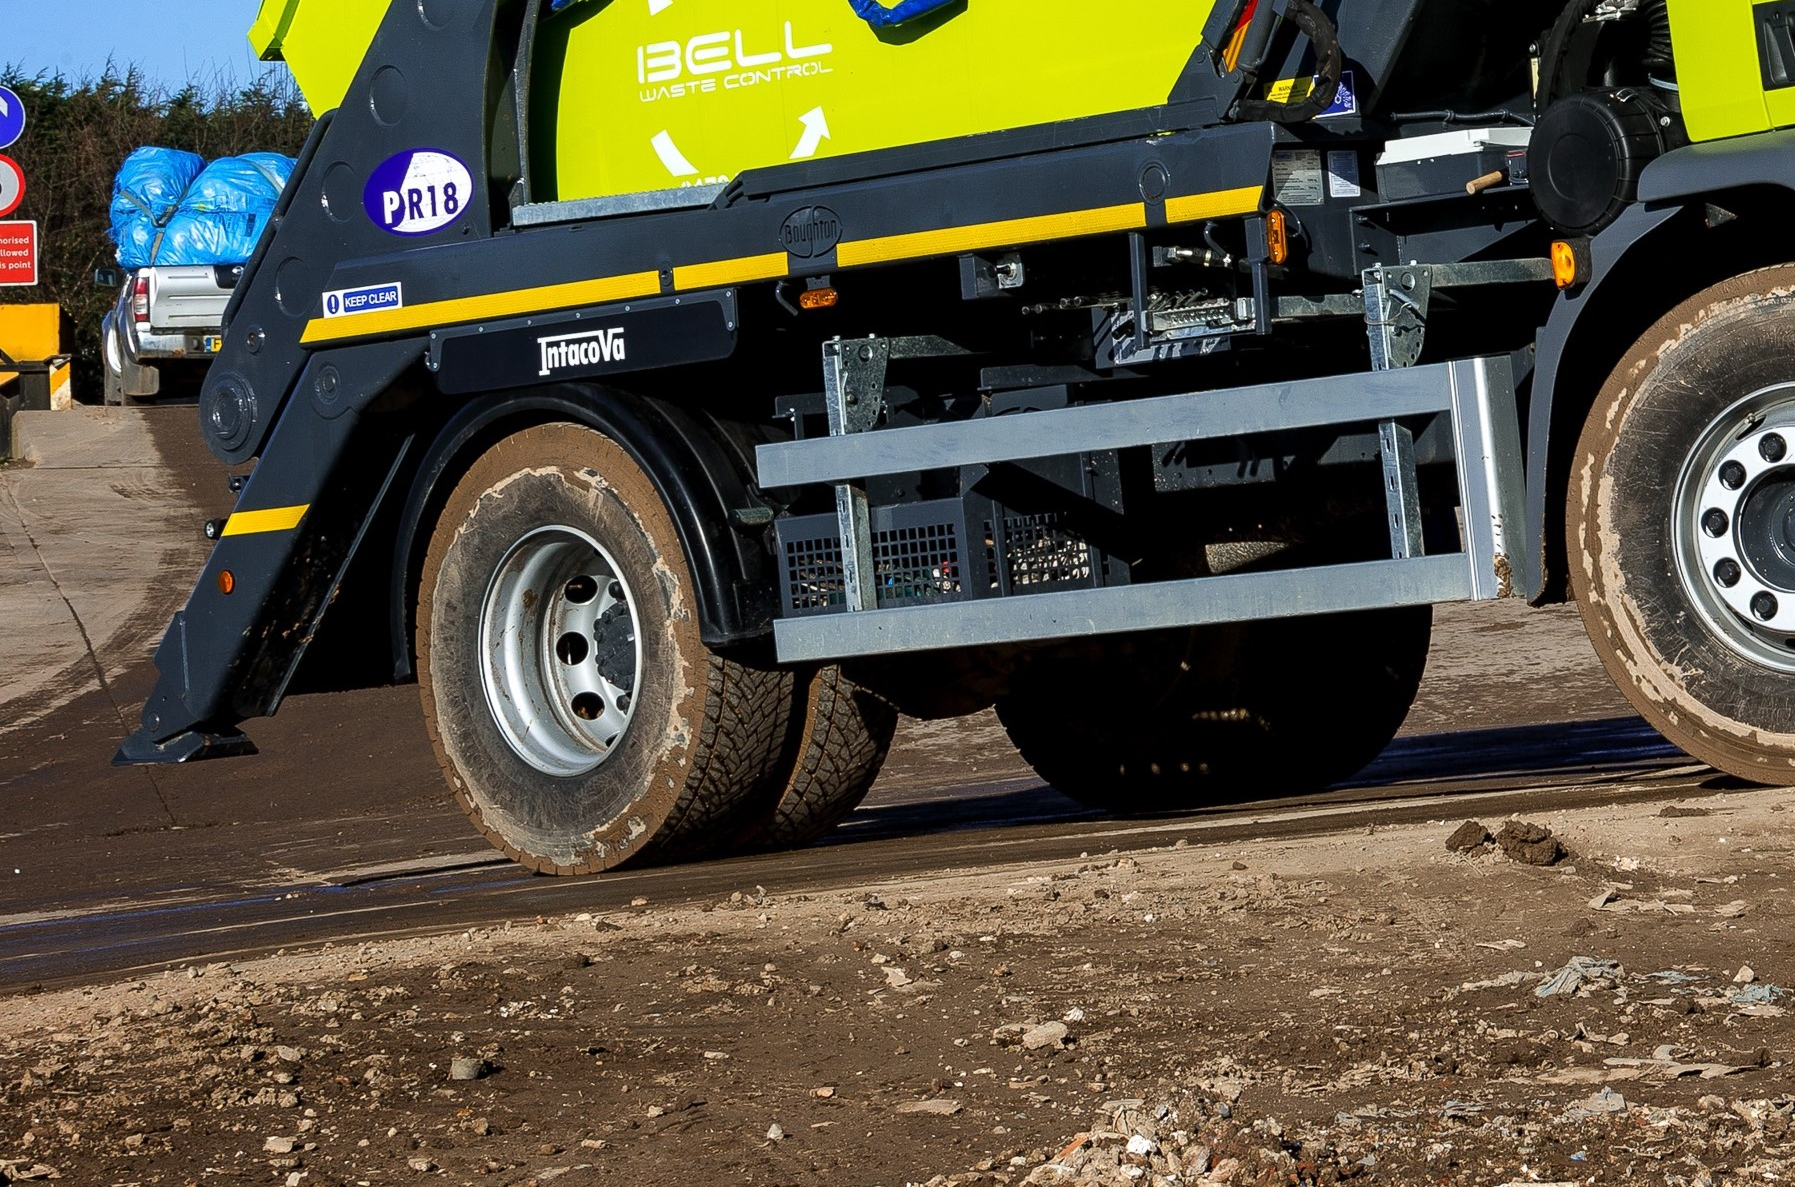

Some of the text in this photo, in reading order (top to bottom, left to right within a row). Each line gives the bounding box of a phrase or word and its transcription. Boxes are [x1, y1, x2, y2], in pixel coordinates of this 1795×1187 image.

[637, 20, 833, 84] BELL
[639, 61, 834, 103] WASTE CONTROL
[383, 182, 460, 225] PR18
[8, 260, 31, 270] point
[344, 290, 397, 309] KEEP CLEAR
